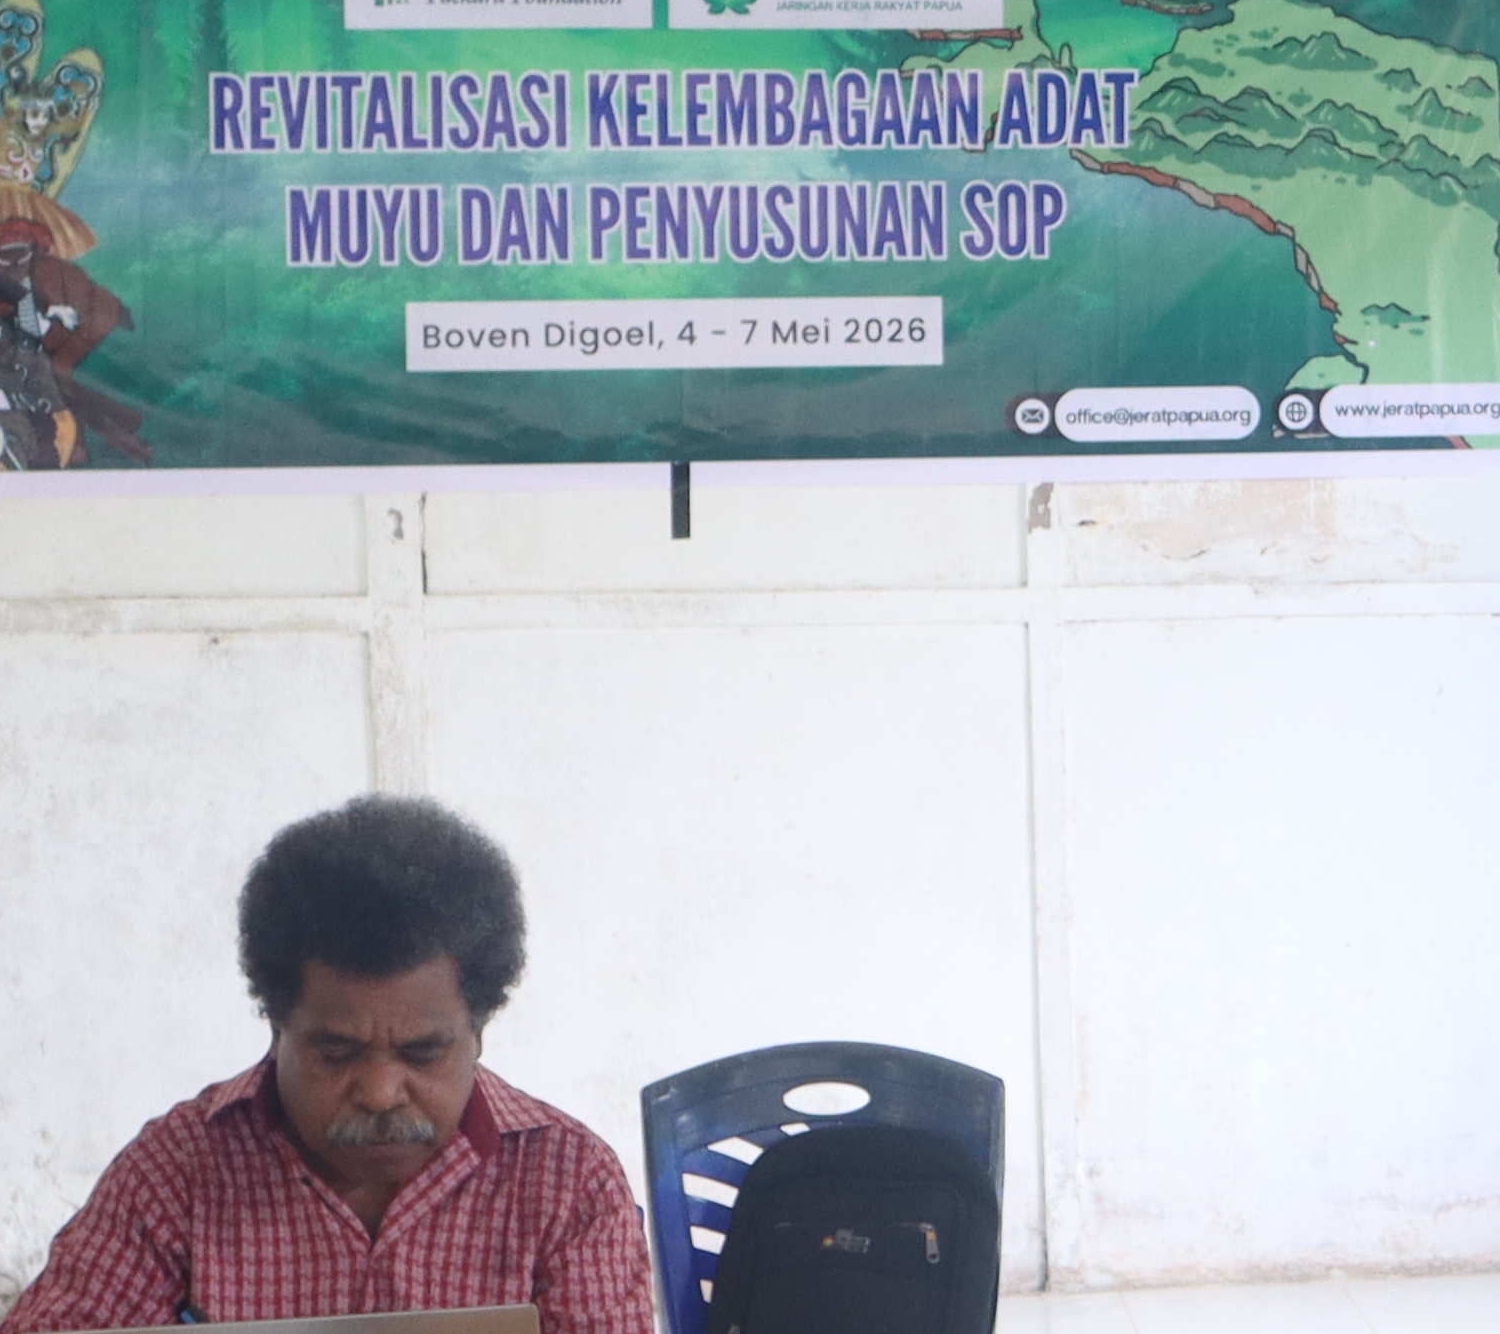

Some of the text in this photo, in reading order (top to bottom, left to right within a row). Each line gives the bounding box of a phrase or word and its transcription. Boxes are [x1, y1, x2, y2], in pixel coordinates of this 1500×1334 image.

[776, 0, 963, 12] JARINGAN KERJA RAKYAT PAPUA
[210, 69, 1138, 152] REVITALISASI KELEMBAGAAN ADAT
[286, 180, 1067, 267] MUYU DAN PENYUSUNAN SOP
[423, 323, 530, 349] Boven
[544, 321, 664, 355] Digoel,
[676, 321, 697, 345] 4
[740, 321, 758, 345] 7
[771, 319, 831, 344] Mei
[844, 318, 927, 344] 2026
[1066, 407, 1252, 427] office@jeratpapua.org
